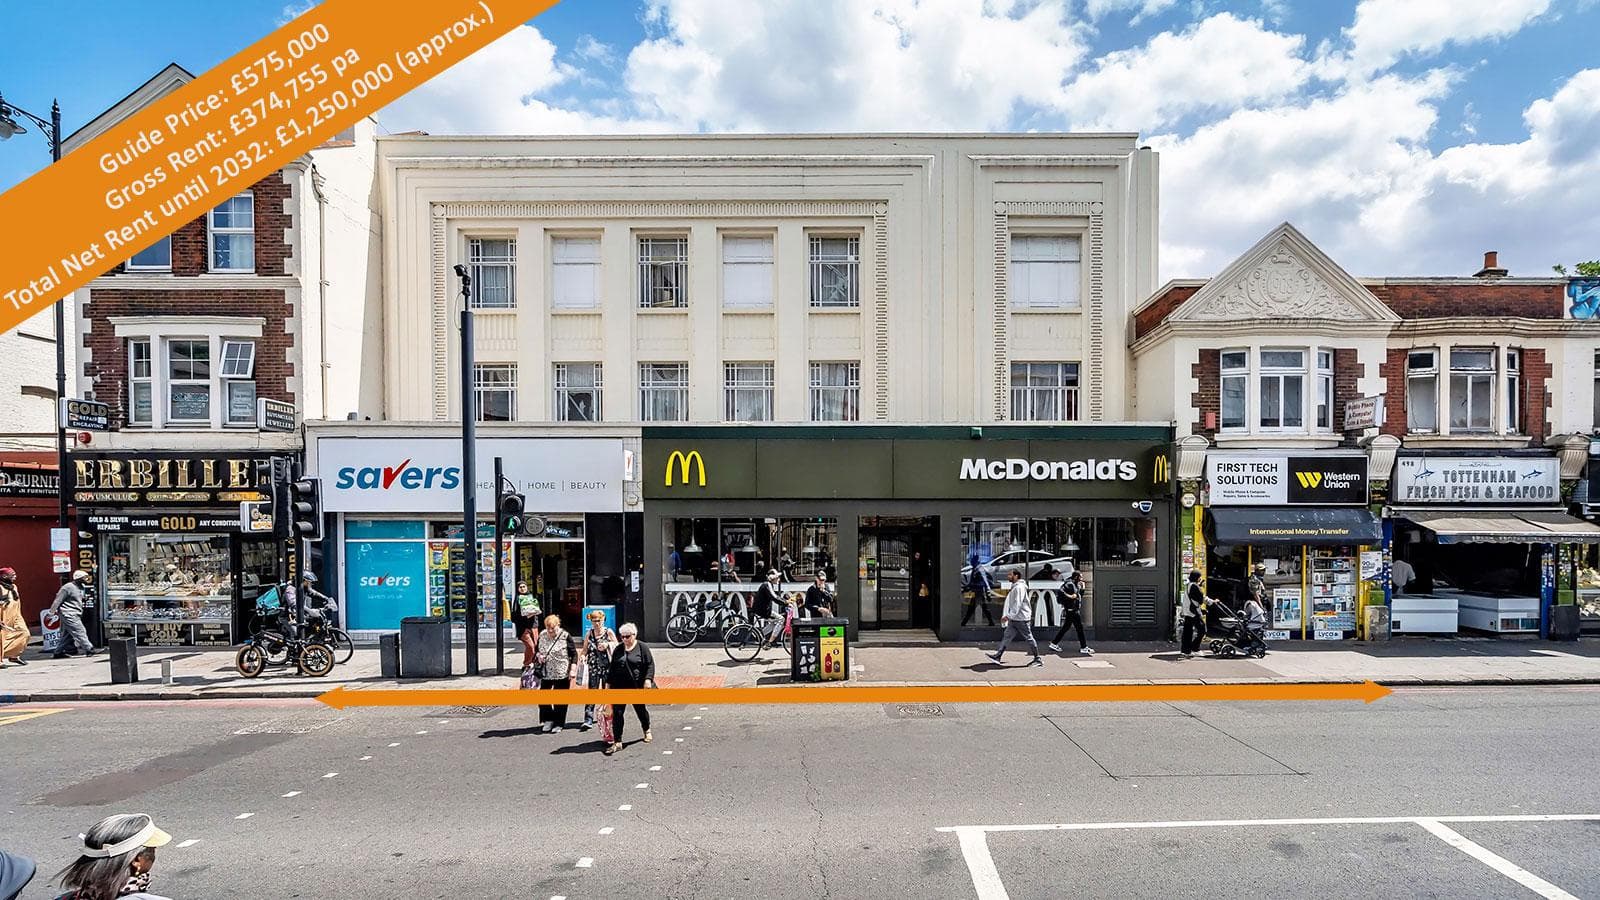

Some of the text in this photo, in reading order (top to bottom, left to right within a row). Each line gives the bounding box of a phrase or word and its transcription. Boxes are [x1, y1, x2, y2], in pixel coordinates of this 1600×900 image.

[69, 402, 108, 416] GOLD
[335, 457, 461, 490] savers
[960, 458, 1137, 480] McDonald's
[1217, 463, 1278, 472] FIRST TECH
[1217, 476, 1278, 484] SOLUTIONS
[1324, 472, 1360, 480] Western
[1443, 470, 1516, 483] TOTTENHAM
[1324, 480, 1350, 489] Union
[1407, 486, 1554, 498] FRESH FISH & SEAFOOD
[161, 517, 196, 530] GOLD
[360, 571, 410, 586] savers
[150, 630, 178, 639] GOLD
